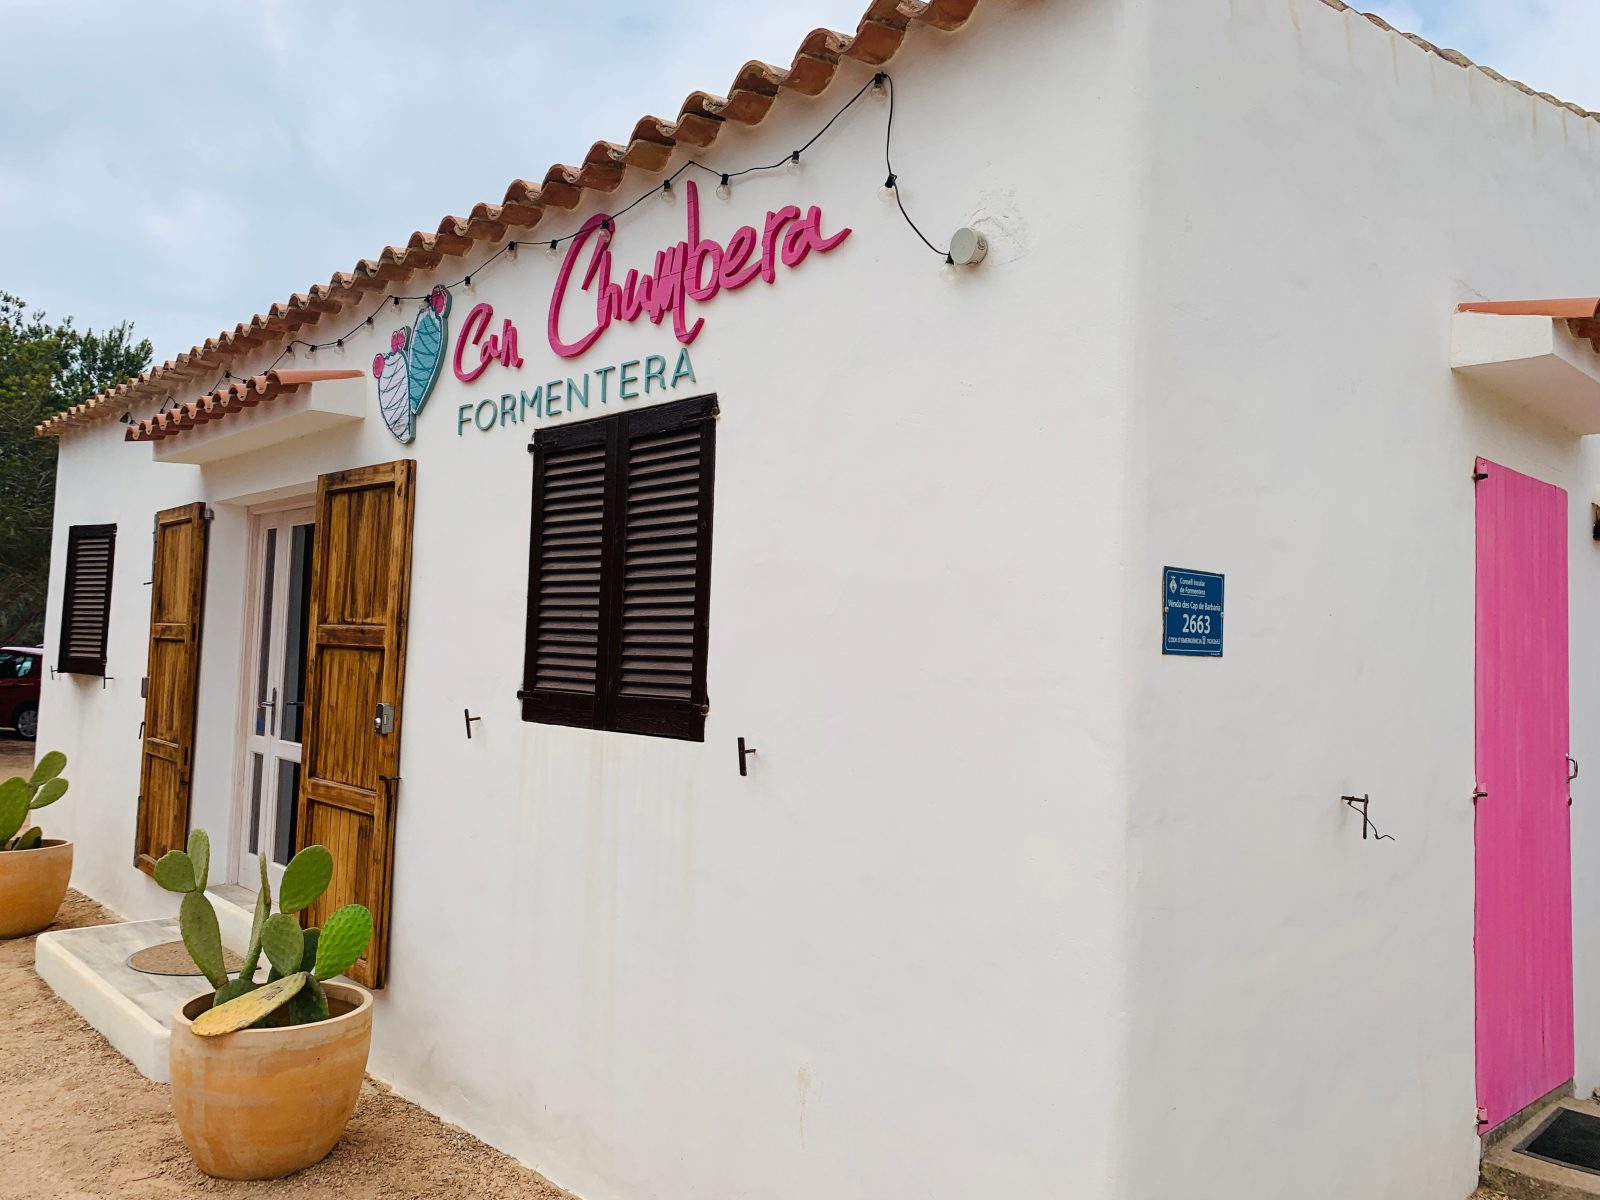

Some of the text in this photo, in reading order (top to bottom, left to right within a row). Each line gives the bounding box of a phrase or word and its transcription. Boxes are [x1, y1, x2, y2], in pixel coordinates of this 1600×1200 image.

[453, 180, 853, 383] Can Chumbera
[457, 347, 697, 437] FORMENTERA
[1180, 577, 1193, 586] Consell
[1185, 586, 1206, 596] Formentera
[1182, 600, 1190, 609] des
[1190, 601, 1198, 611] Cap
[1199, 602, 1204, 610] de
[1182, 613, 1211, 634] 2663
